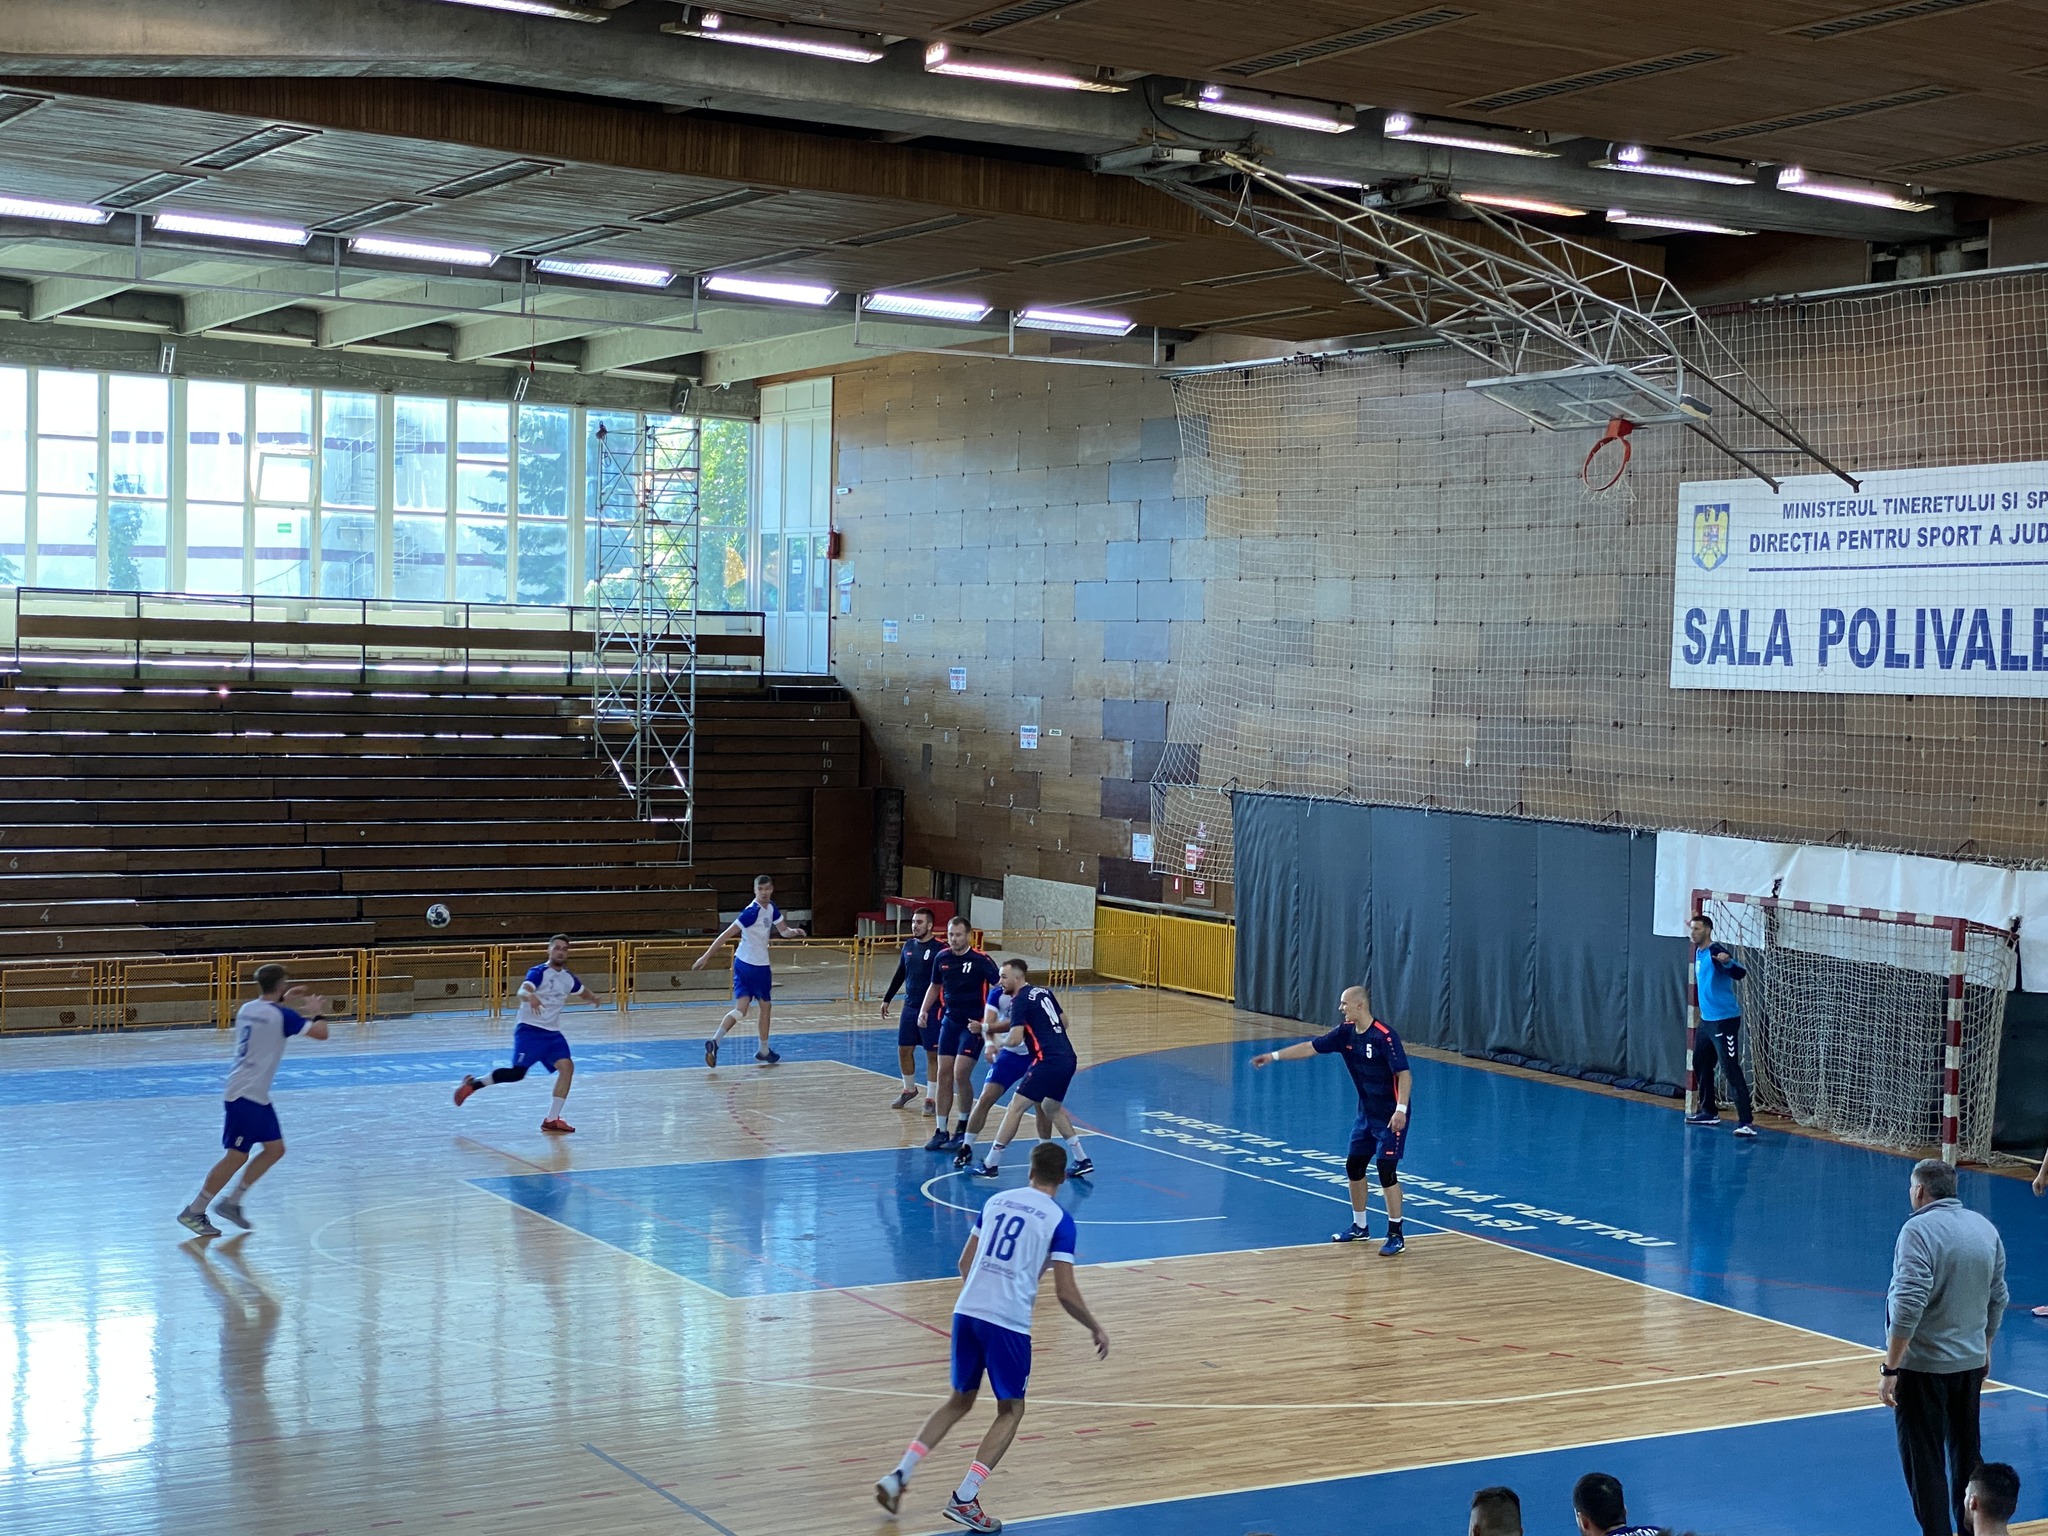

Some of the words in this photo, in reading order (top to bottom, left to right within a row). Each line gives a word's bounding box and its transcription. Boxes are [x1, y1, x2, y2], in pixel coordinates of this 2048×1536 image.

[1782, 500, 1878, 520] MINISTERUL
[1883, 493, 1996, 516] TINERETULUI
[1749, 531, 1831, 554] DIRECȚIA
[1836, 527, 1911, 551] PENTRU
[1916, 524, 1982, 548] SPORT
[1989, 524, 2003, 546] A
[1682, 607, 1794, 667] SALA
[1817, 606, 2048, 672] POLIVALE
[822, 759, 832, 769] 10
[966, 753, 971, 764] 7
[822, 775, 829, 784] 9
[989, 776, 995, 787] 6
[1029, 815, 1034, 826] 4
[1057, 839, 1062, 850] 3
[9, 857, 19, 869] 6
[1079, 861, 1085, 873] 2
[40, 909, 49, 922] 4
[56, 936, 64, 949] 3
[923, 949, 931, 960] 8
[962, 962, 972, 973] 11
[1041, 996, 1060, 1026] 10
[1366, 1043, 1373, 1059] 5
[1140, 1128, 1258, 1155] SPORT
[1492, 1203, 1677, 1247] PENTRU
[986, 1212, 1025, 1261] 18
